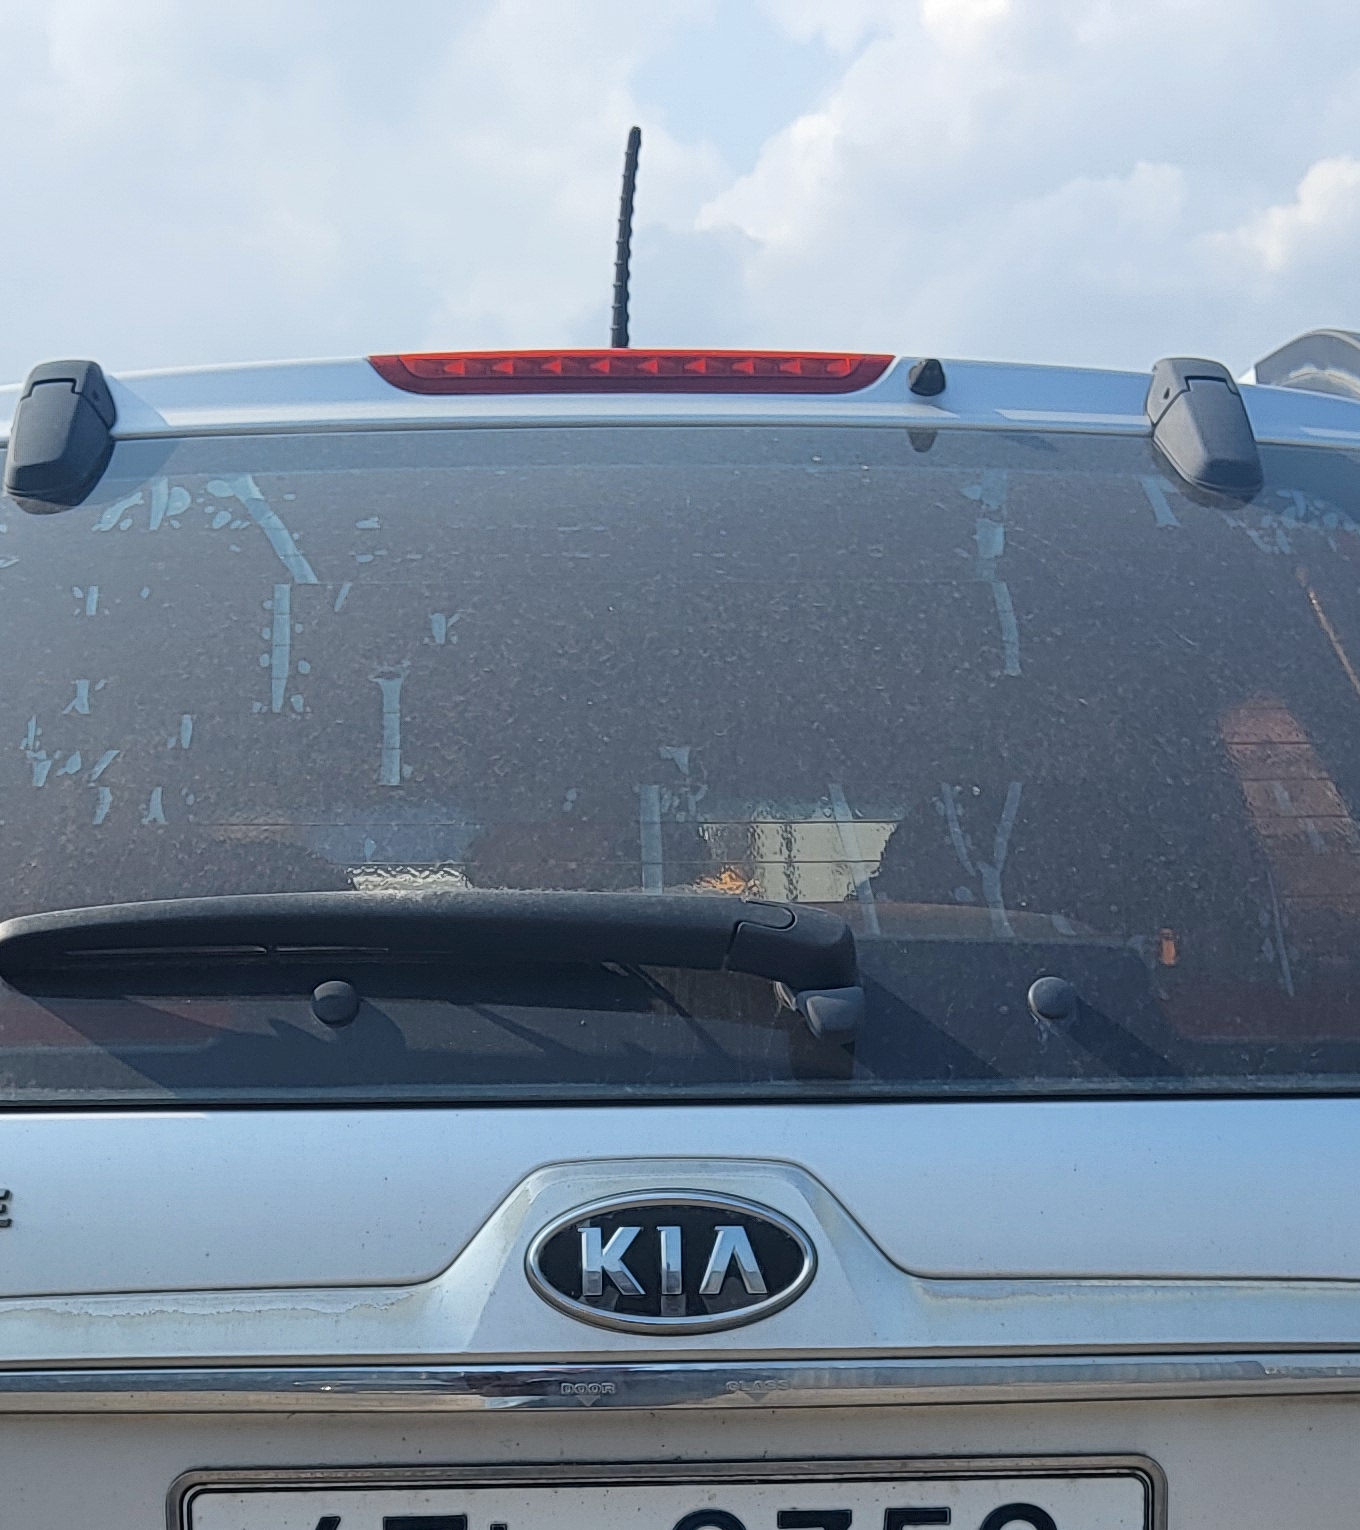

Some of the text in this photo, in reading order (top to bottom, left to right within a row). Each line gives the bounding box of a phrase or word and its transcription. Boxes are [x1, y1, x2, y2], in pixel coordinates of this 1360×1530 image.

[577, 1225, 768, 1296] KIA
[560, 1379, 790, 1395] DOOR GLASS
